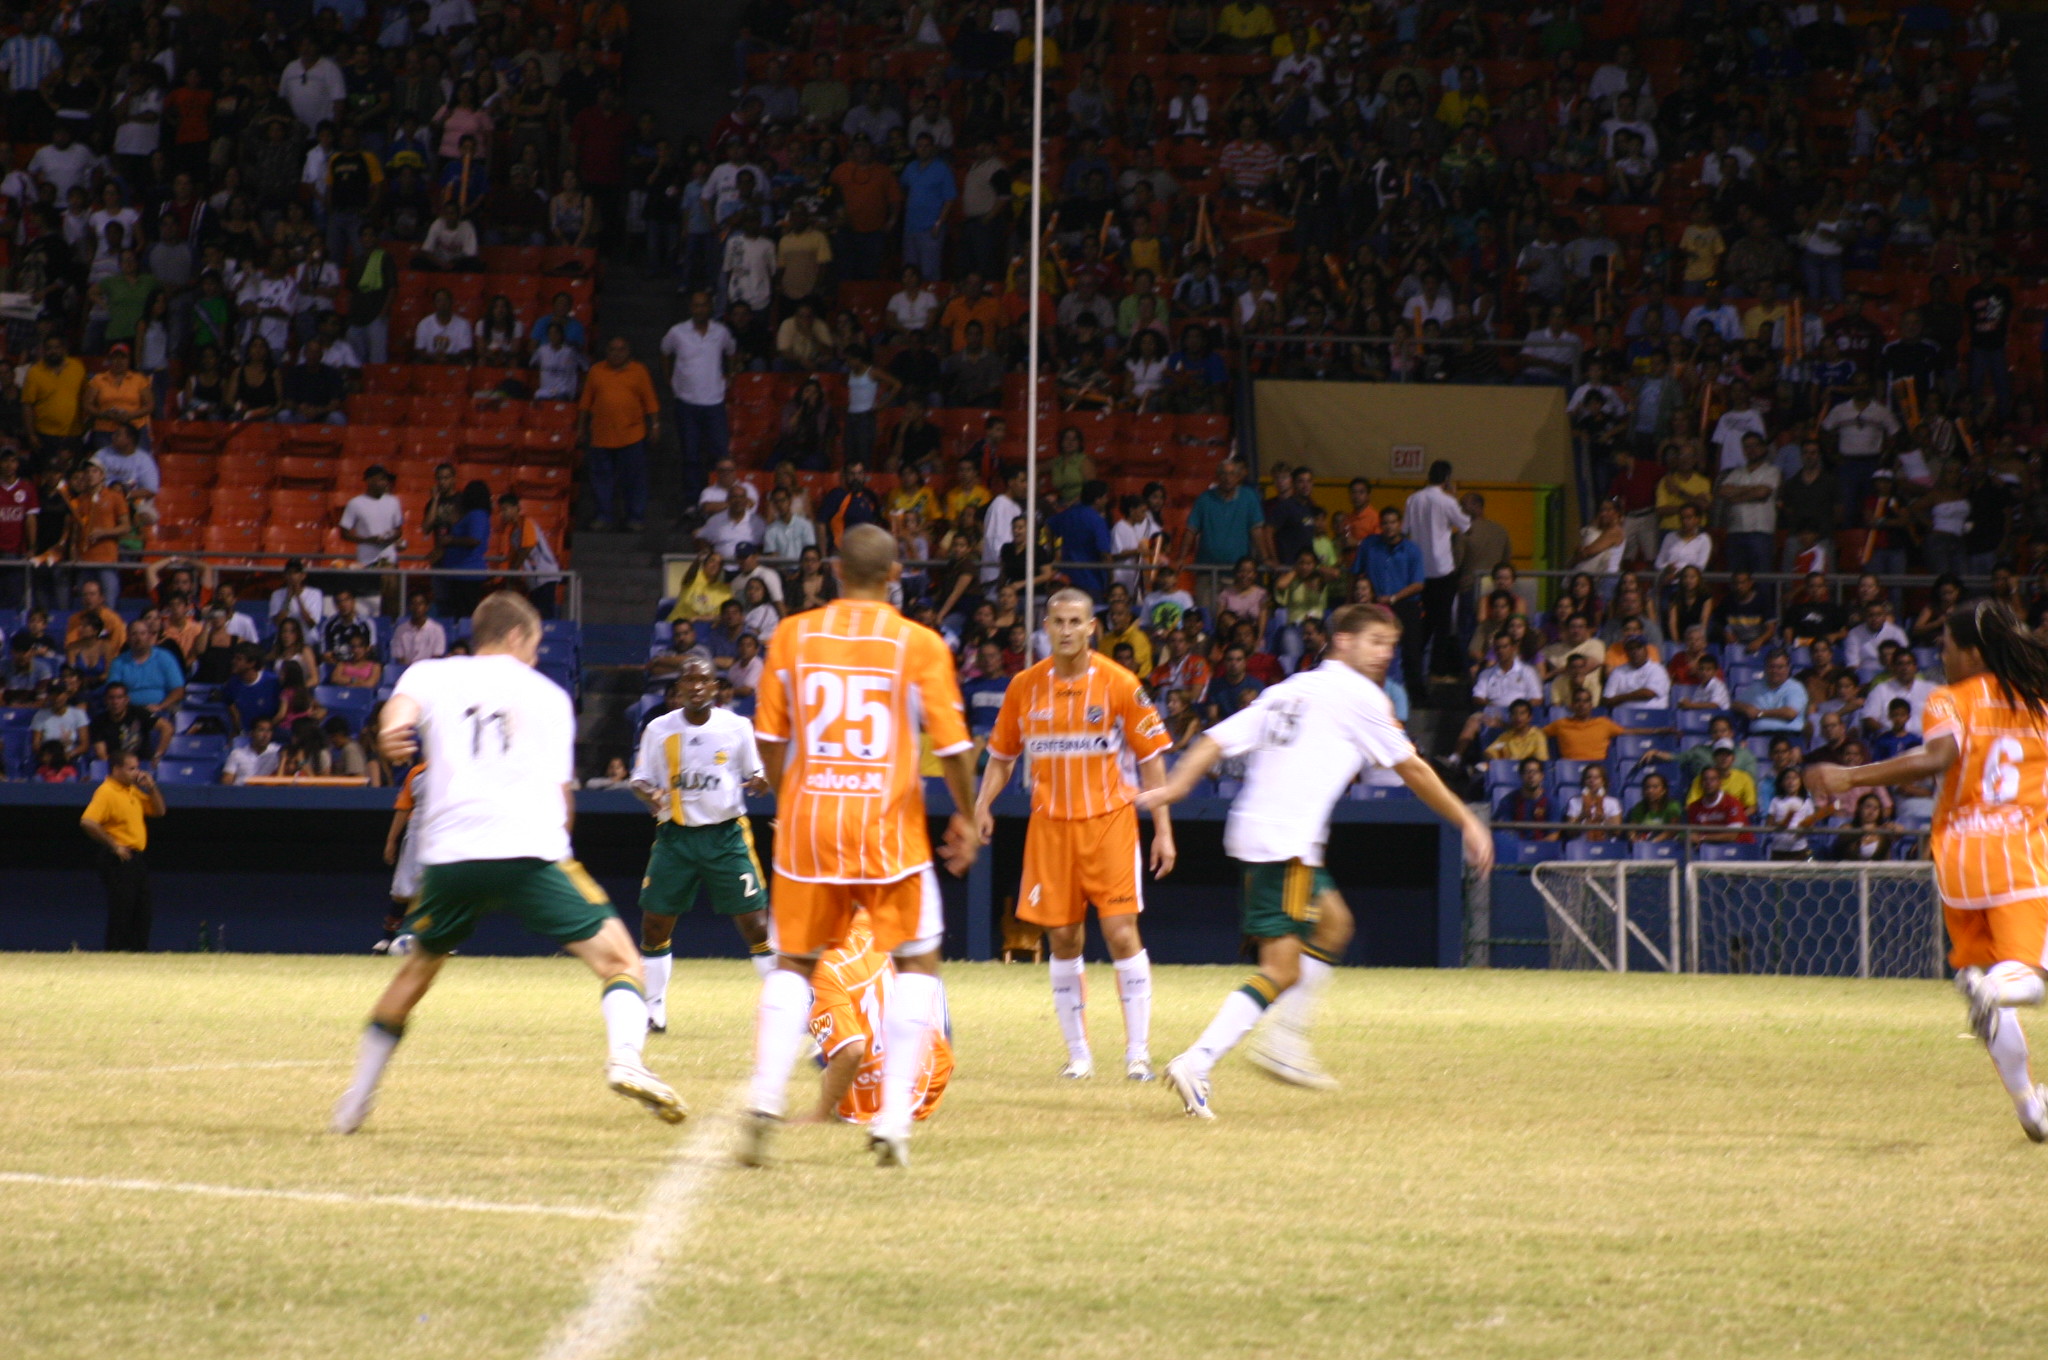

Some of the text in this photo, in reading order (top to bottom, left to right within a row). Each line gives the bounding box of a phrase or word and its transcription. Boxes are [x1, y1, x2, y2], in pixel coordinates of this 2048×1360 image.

[1394, 450, 1420, 467] EXIT
[805, 671, 892, 760] 25
[1982, 735, 2024, 805] 6
[739, 872, 760, 897] 2
[1028, 883, 1042, 907] 4
